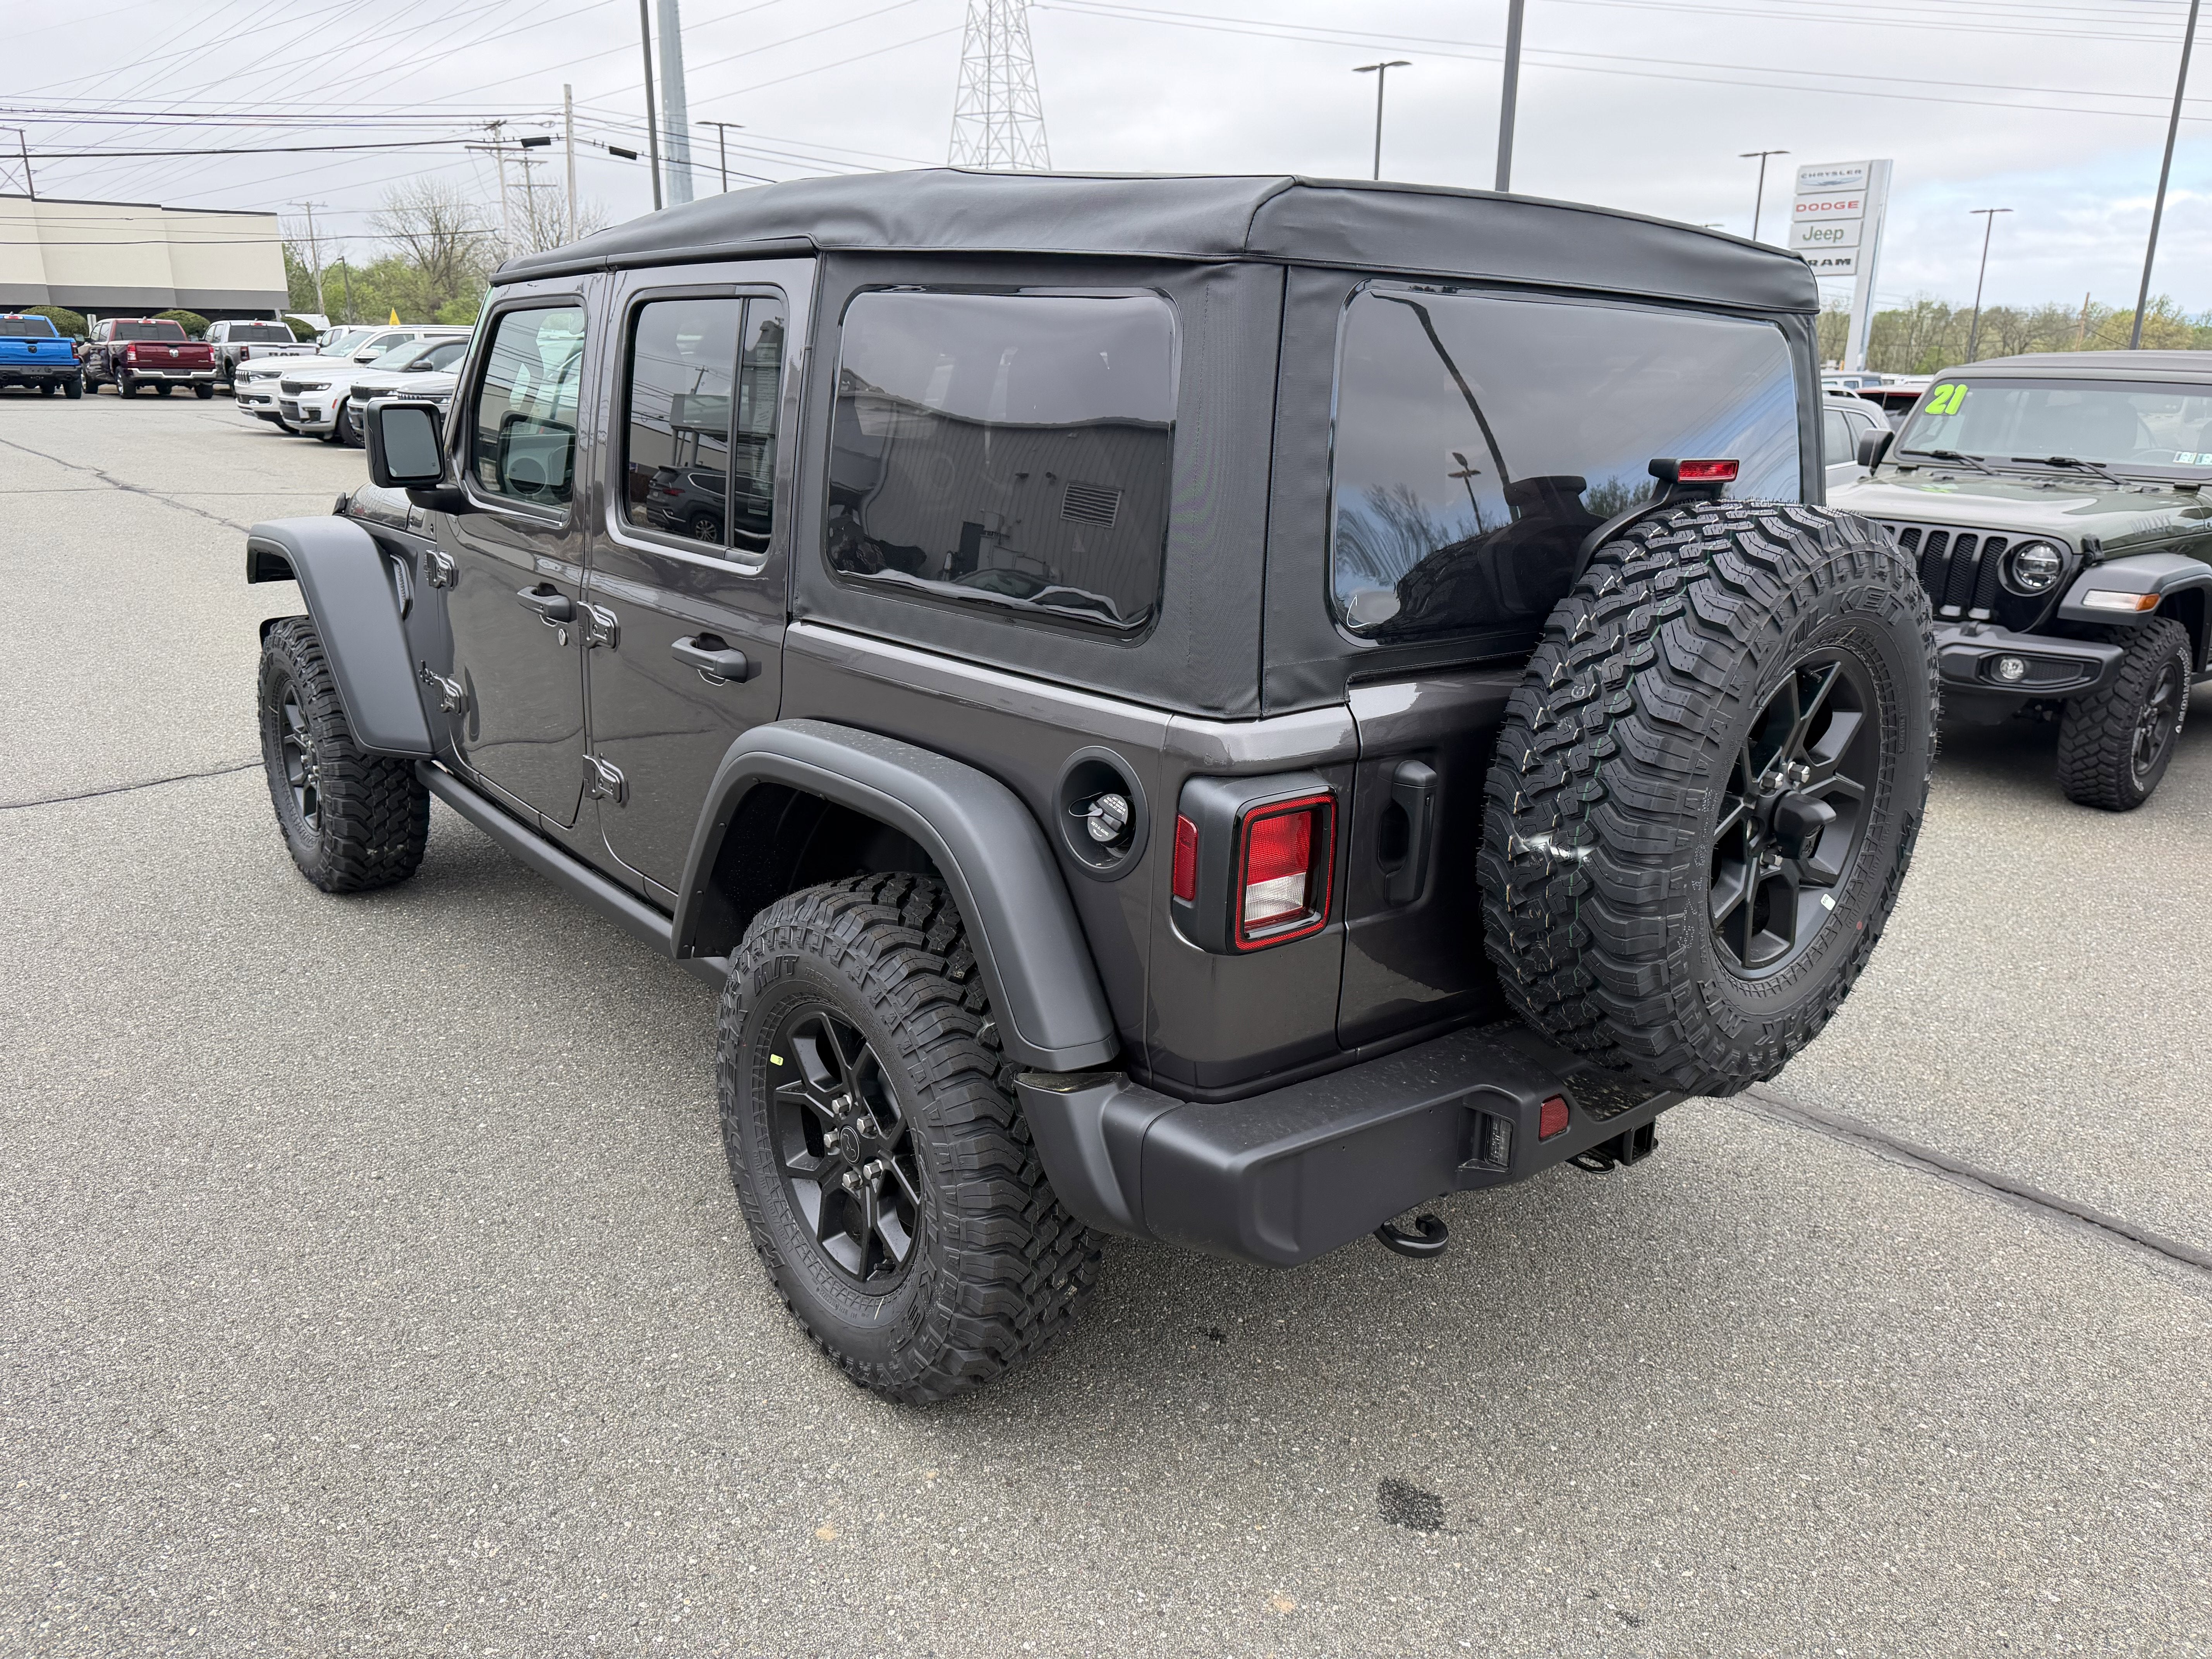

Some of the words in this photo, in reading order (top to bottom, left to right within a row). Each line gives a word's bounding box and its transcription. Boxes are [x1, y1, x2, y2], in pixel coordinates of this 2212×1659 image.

[1801, 169, 1862, 179] CHRYSLER
[1796, 200, 1859, 212] DODGE
[1803, 226, 1844, 243] Jeep
[1808, 258, 1851, 266] RAM
[1925, 384, 1968, 415] 21
[752, 954, 799, 996] M/T
